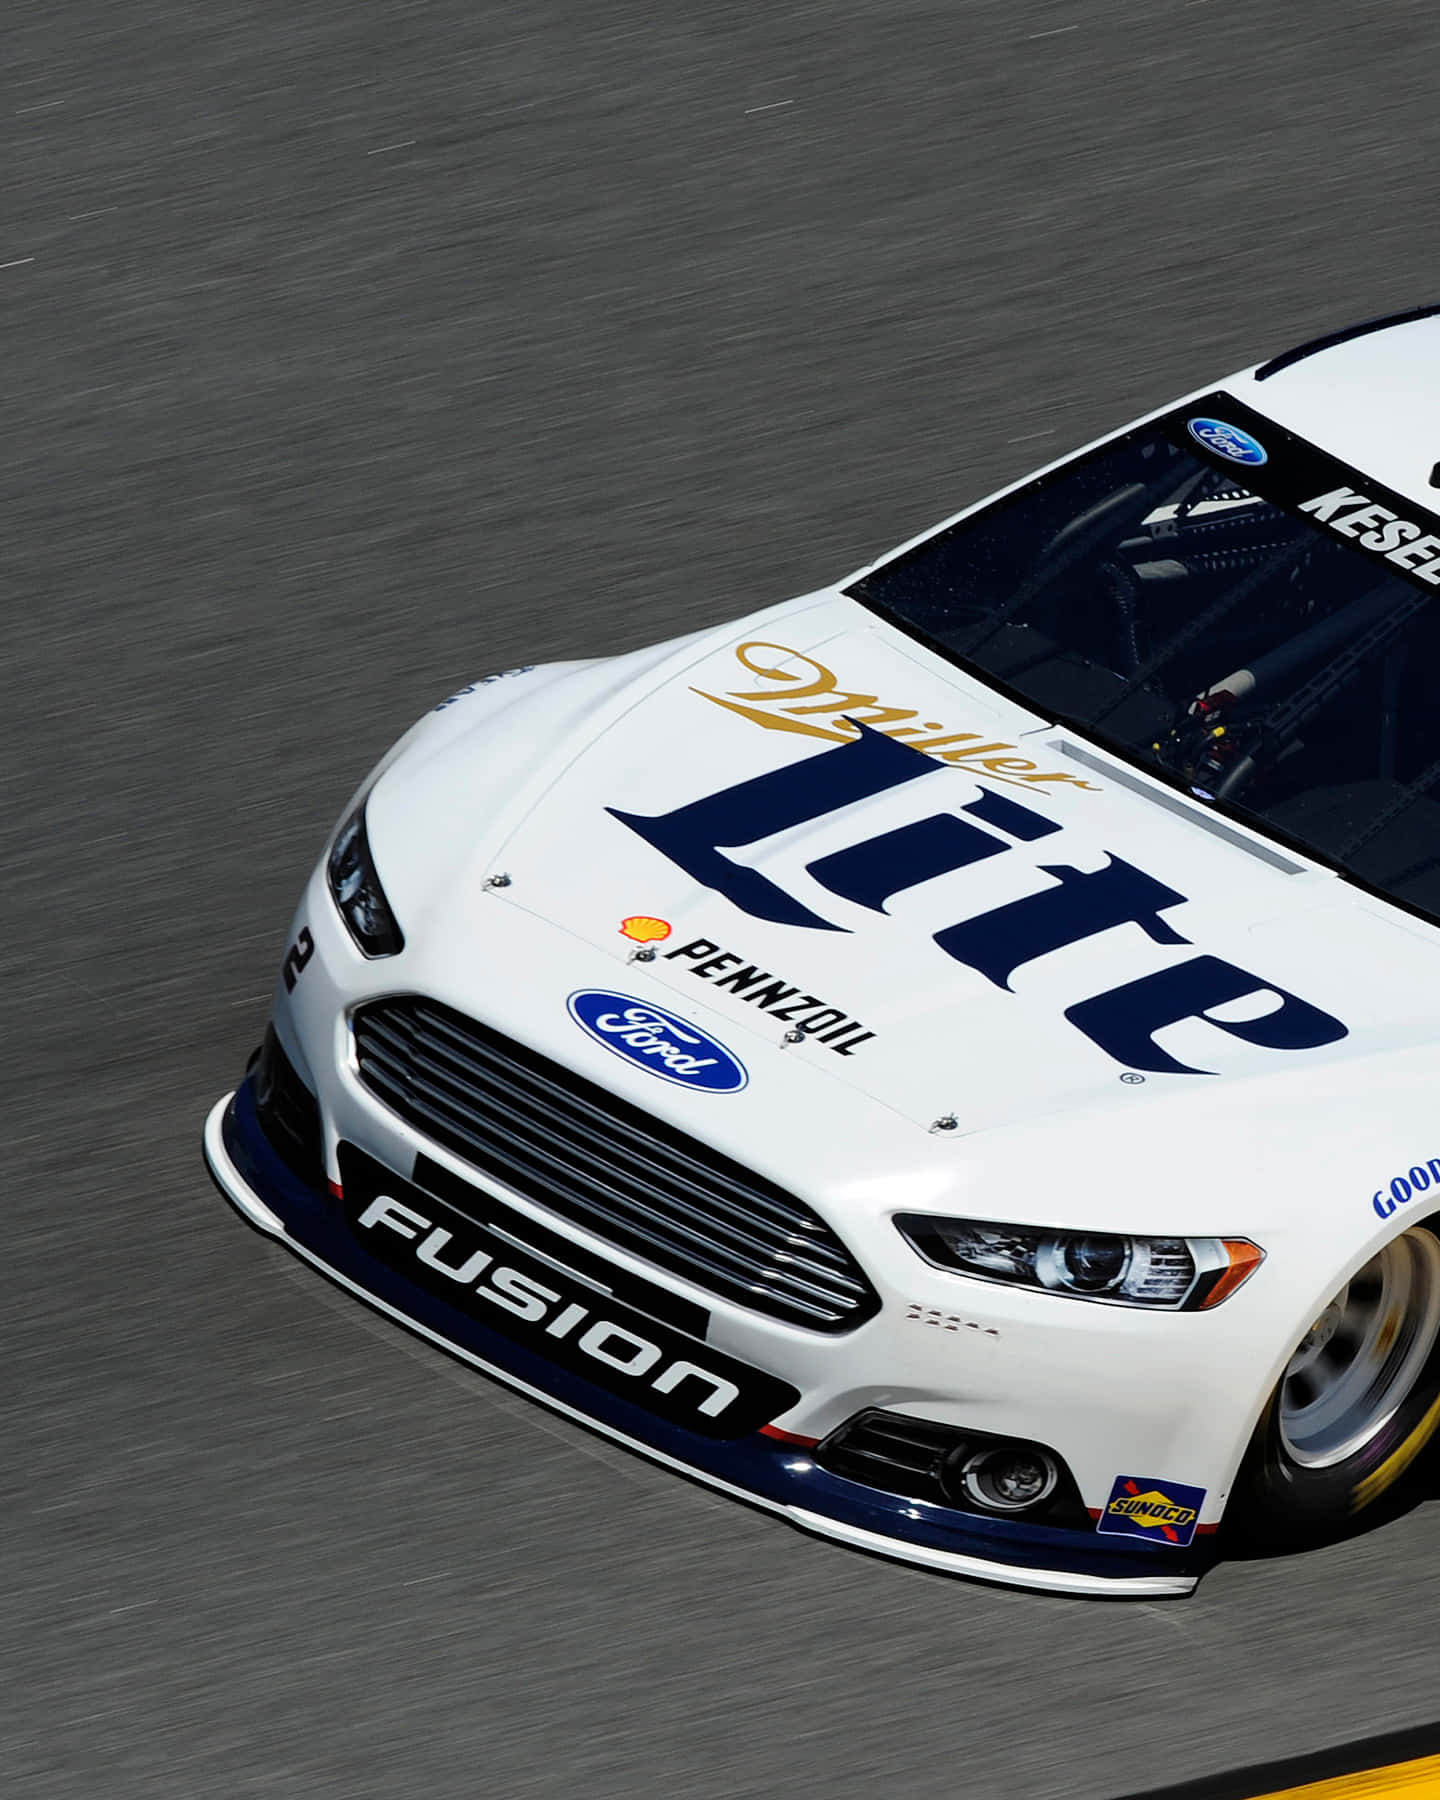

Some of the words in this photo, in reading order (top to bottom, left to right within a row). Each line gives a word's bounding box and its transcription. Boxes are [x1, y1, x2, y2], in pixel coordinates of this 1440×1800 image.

[688, 641, 1103, 795] Miller
[604, 714, 1350, 1075] Lite
[282, 926, 315, 995] 2
[665, 938, 880, 1057] PENNZOIL
[1111, 1500, 1193, 1524] SUNOCO
